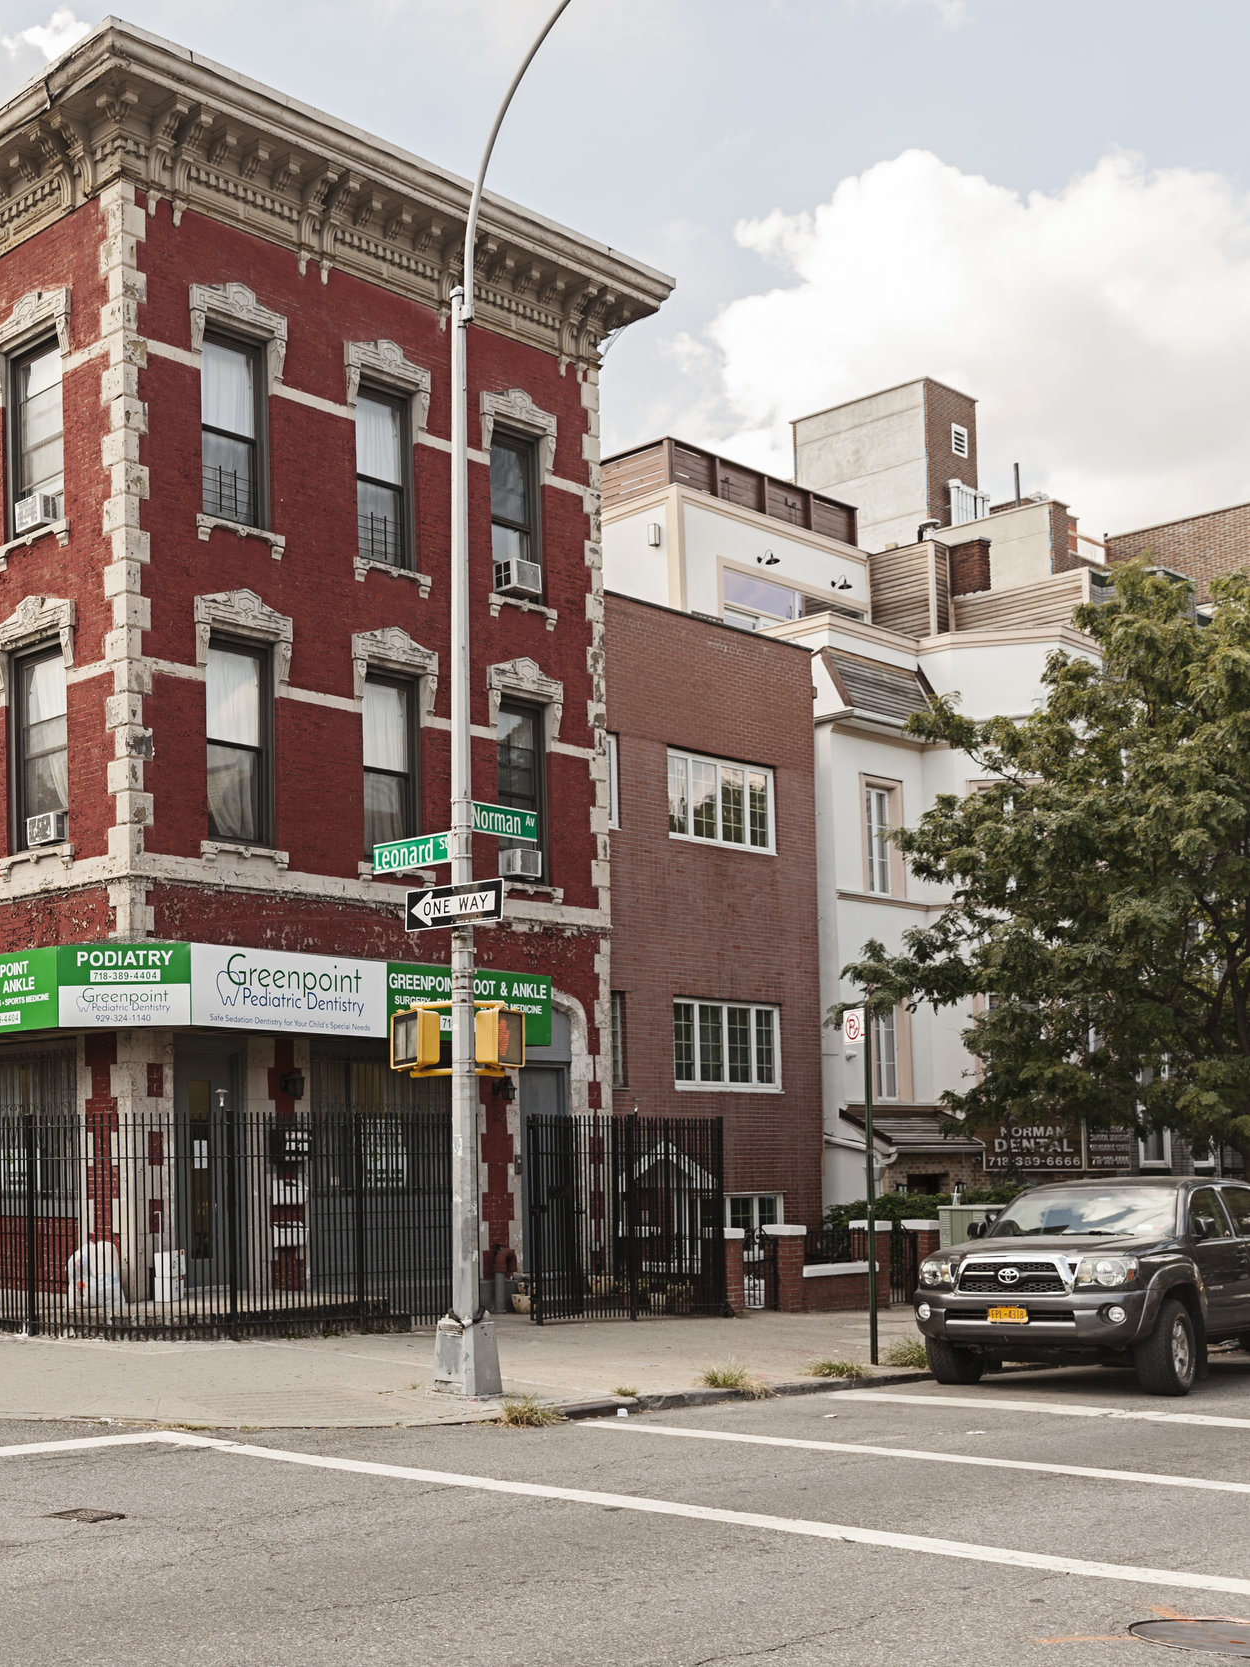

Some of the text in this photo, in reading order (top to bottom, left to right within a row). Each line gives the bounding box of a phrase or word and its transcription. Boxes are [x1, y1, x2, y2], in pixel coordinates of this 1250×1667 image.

[473, 806, 535, 834] Norman Av
[375, 837, 449, 870] Leonard St
[423, 894, 488, 916] ONE WAY
[77, 950, 174, 967] PODIATRY
[93, 971, 158, 980] 718-389-4404
[227, 953, 362, 997] Greenpoint
[2, 976, 36, 994] ANKLE
[388, 973, 547, 999] GREENPOIN OOT & ANKLE
[4, 996, 25, 1006] SPORTS
[26, 993, 50, 1003] MEDICINE
[82, 987, 170, 1006] Greenpoint
[242, 987, 365, 1017] Pediatric Dentistry
[91, 1002, 171, 1013] Pediatric Dentistry
[95, 1014, 152, 1022] 929-324-1140
[210, 1014, 224, 1022] Safe
[225, 1015, 253, 1024] Sedation
[255, 1017, 282, 1028] Dentistry
[284, 1018, 293, 1027] for
[352, 1023, 371, 1032] Needs
[1000, 1126, 1065, 1137] NORMAN
